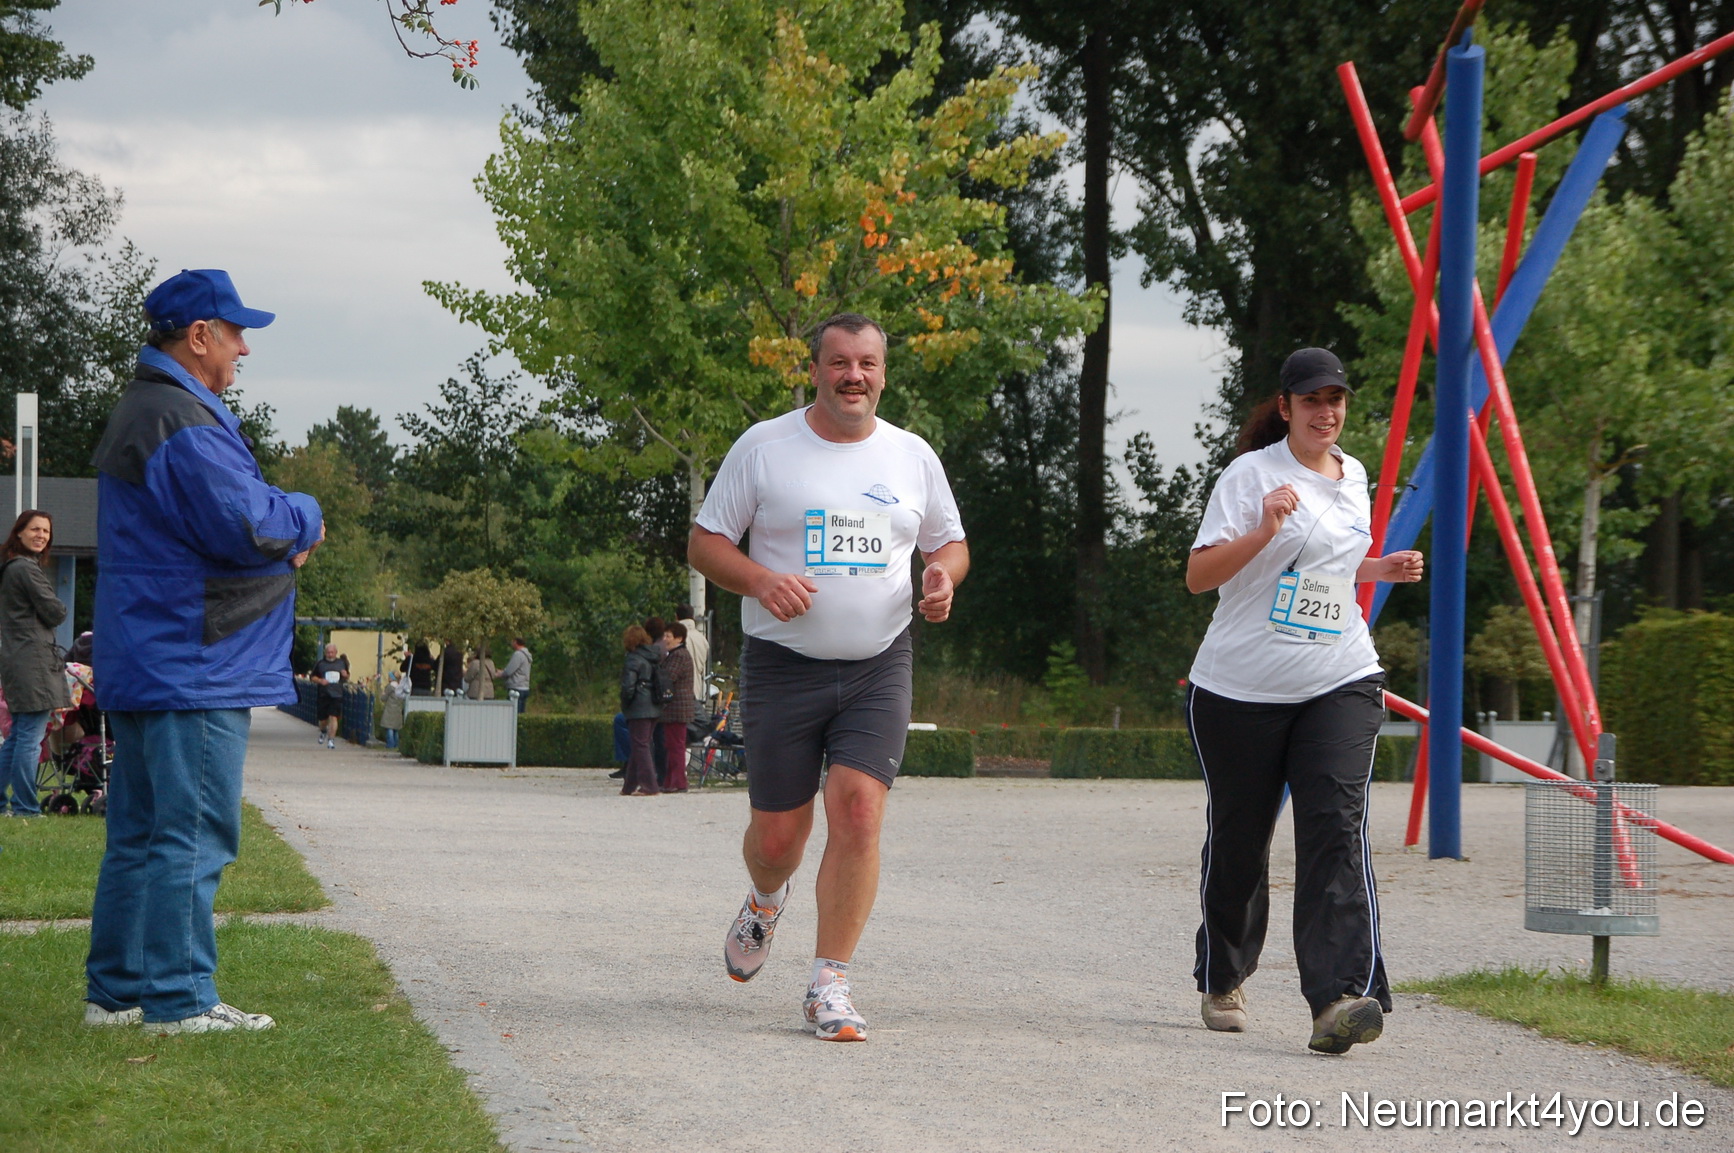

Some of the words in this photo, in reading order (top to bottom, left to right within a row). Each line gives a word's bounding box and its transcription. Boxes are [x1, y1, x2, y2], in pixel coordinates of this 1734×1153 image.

[831, 515, 865, 528] Roland
[832, 534, 882, 554] 2130
[1302, 578, 1330, 594] Selma
[1296, 598, 1341, 621] 2213
